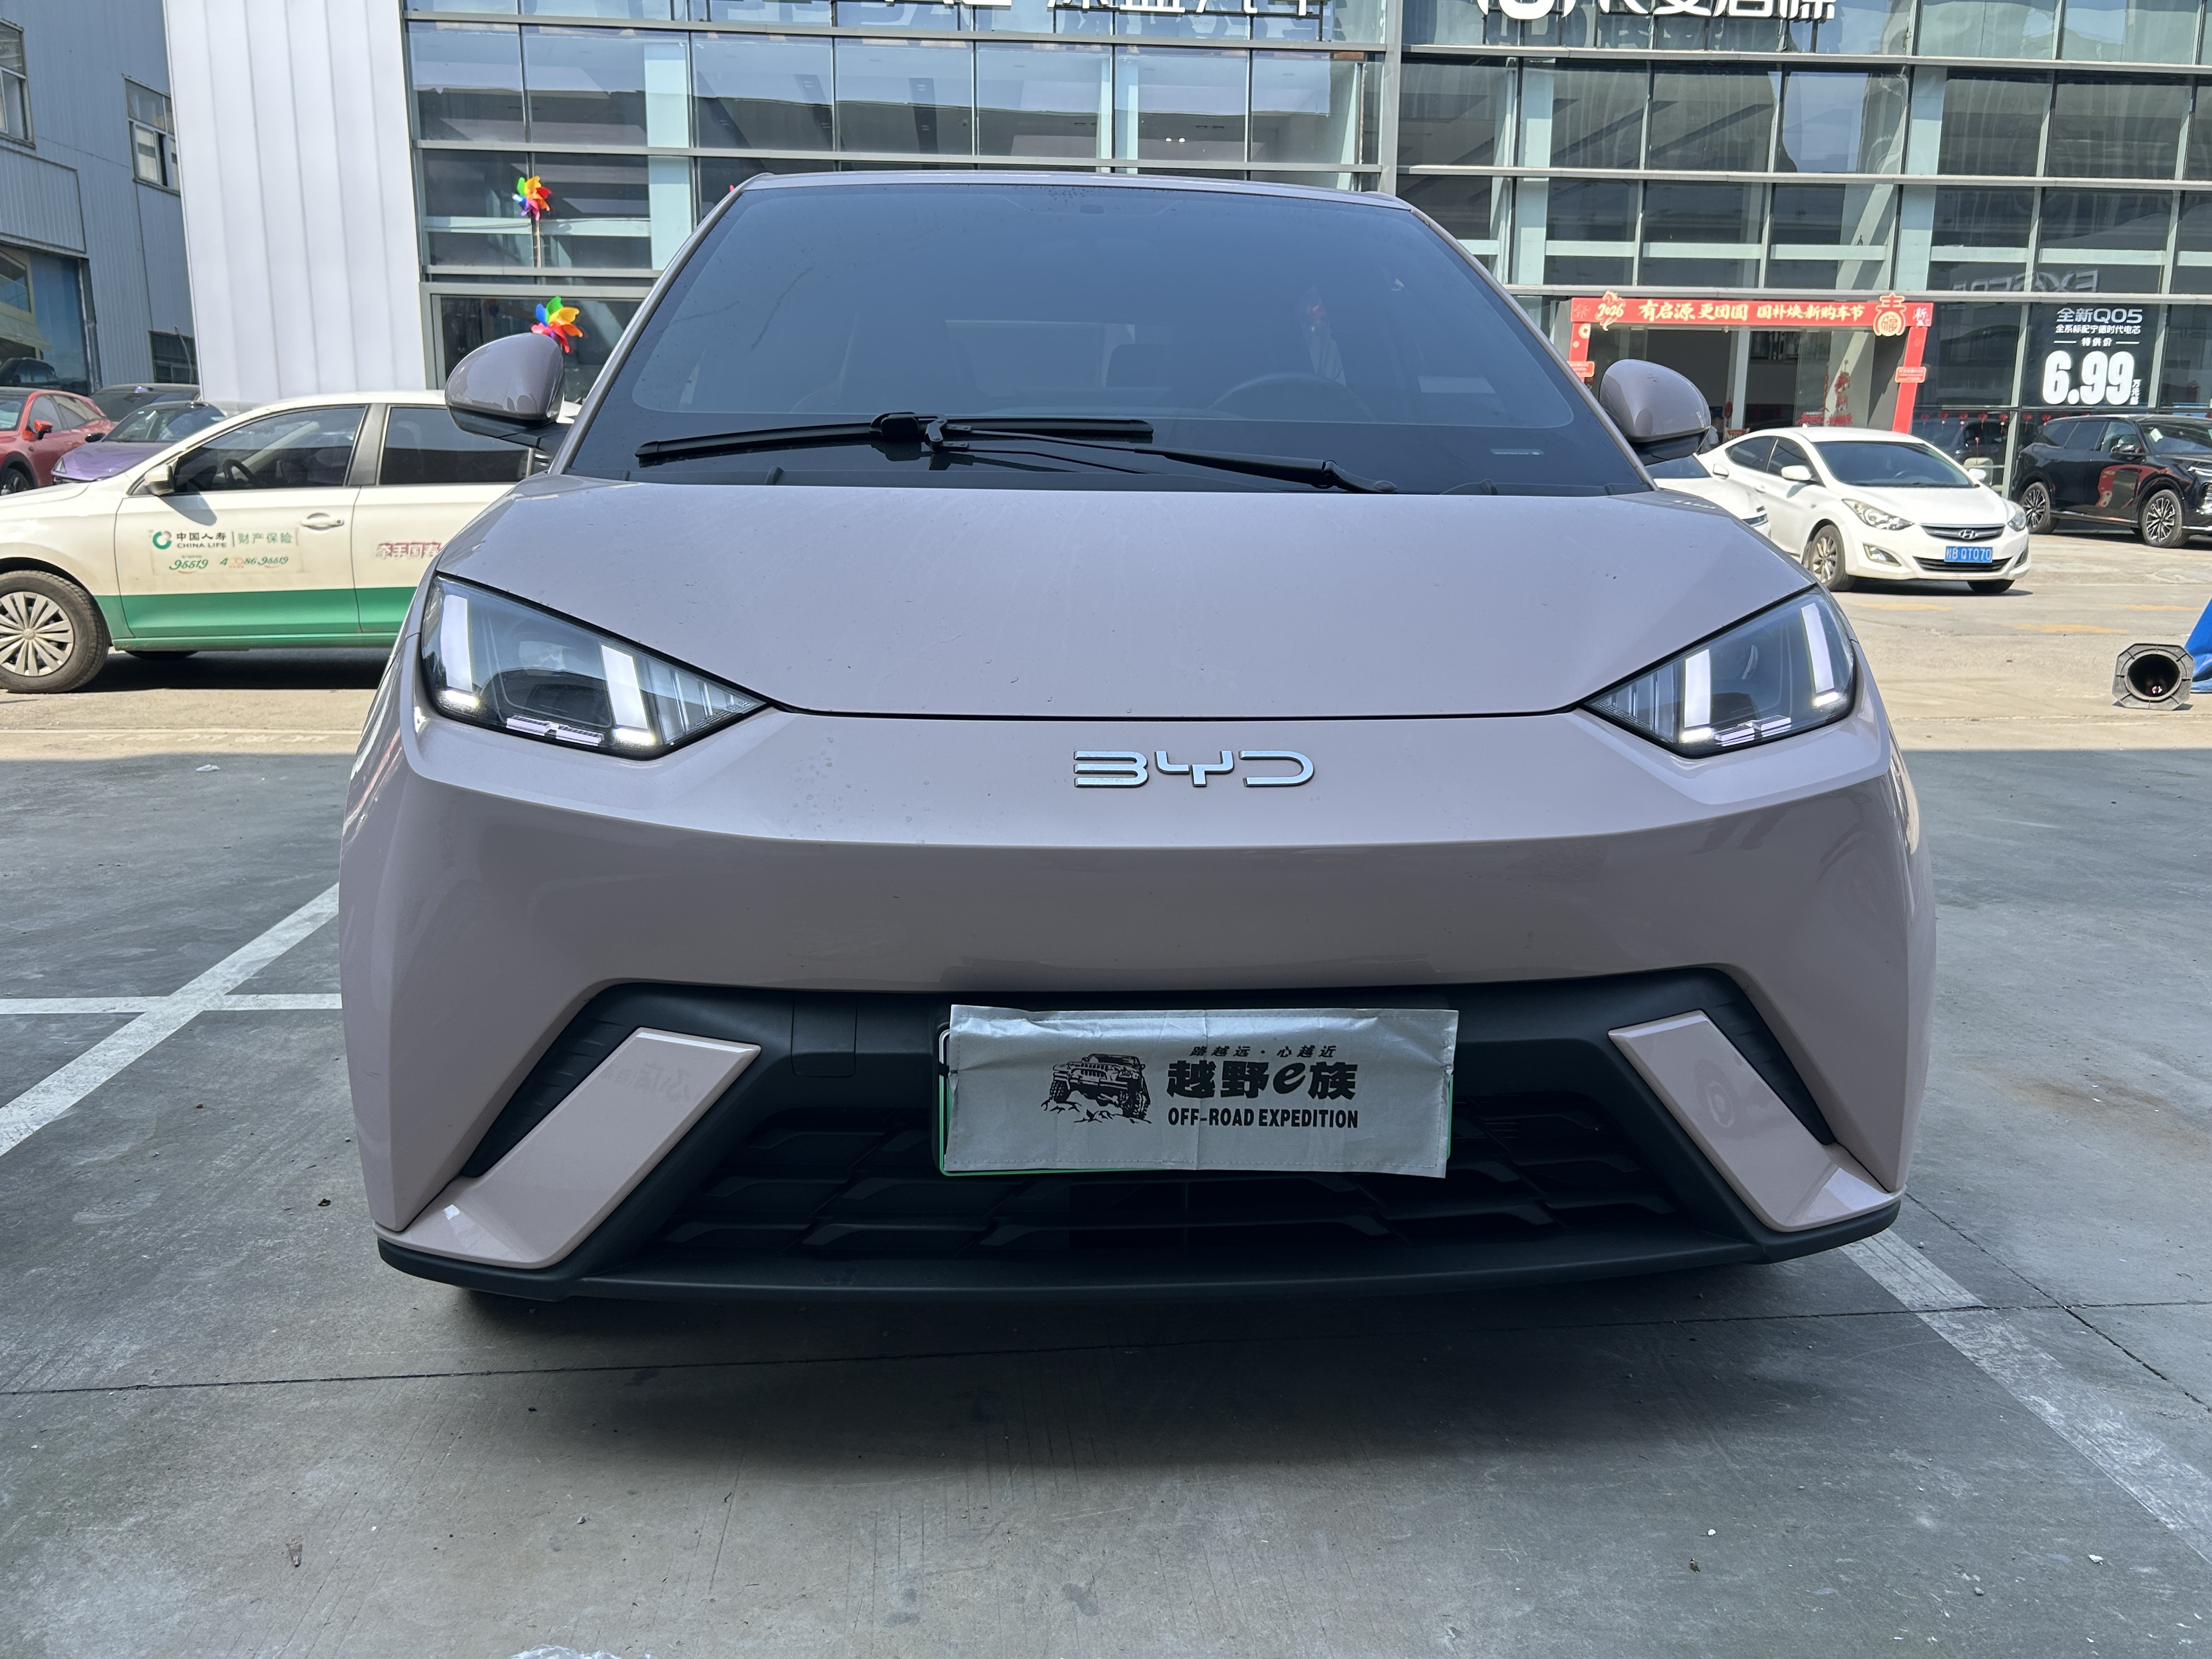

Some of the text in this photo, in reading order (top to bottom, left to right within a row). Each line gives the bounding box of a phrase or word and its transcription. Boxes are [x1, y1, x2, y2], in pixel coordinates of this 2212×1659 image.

[1596, 303, 1624, 318] 2026
[1638, 300, 1865, 322] 有启源 更团圆 国补焕新购车节
[2042, 350, 2135, 405] 6.99
[176, 532, 293, 544] 中国人寿 财产保险
[169, 558, 209, 571] 95519
[1074, 750, 1315, 787] BYD
[1166, 1059, 1359, 1101] 越野e族
[1167, 1107, 1359, 1128] OFF-ROAD EXPEDITION
